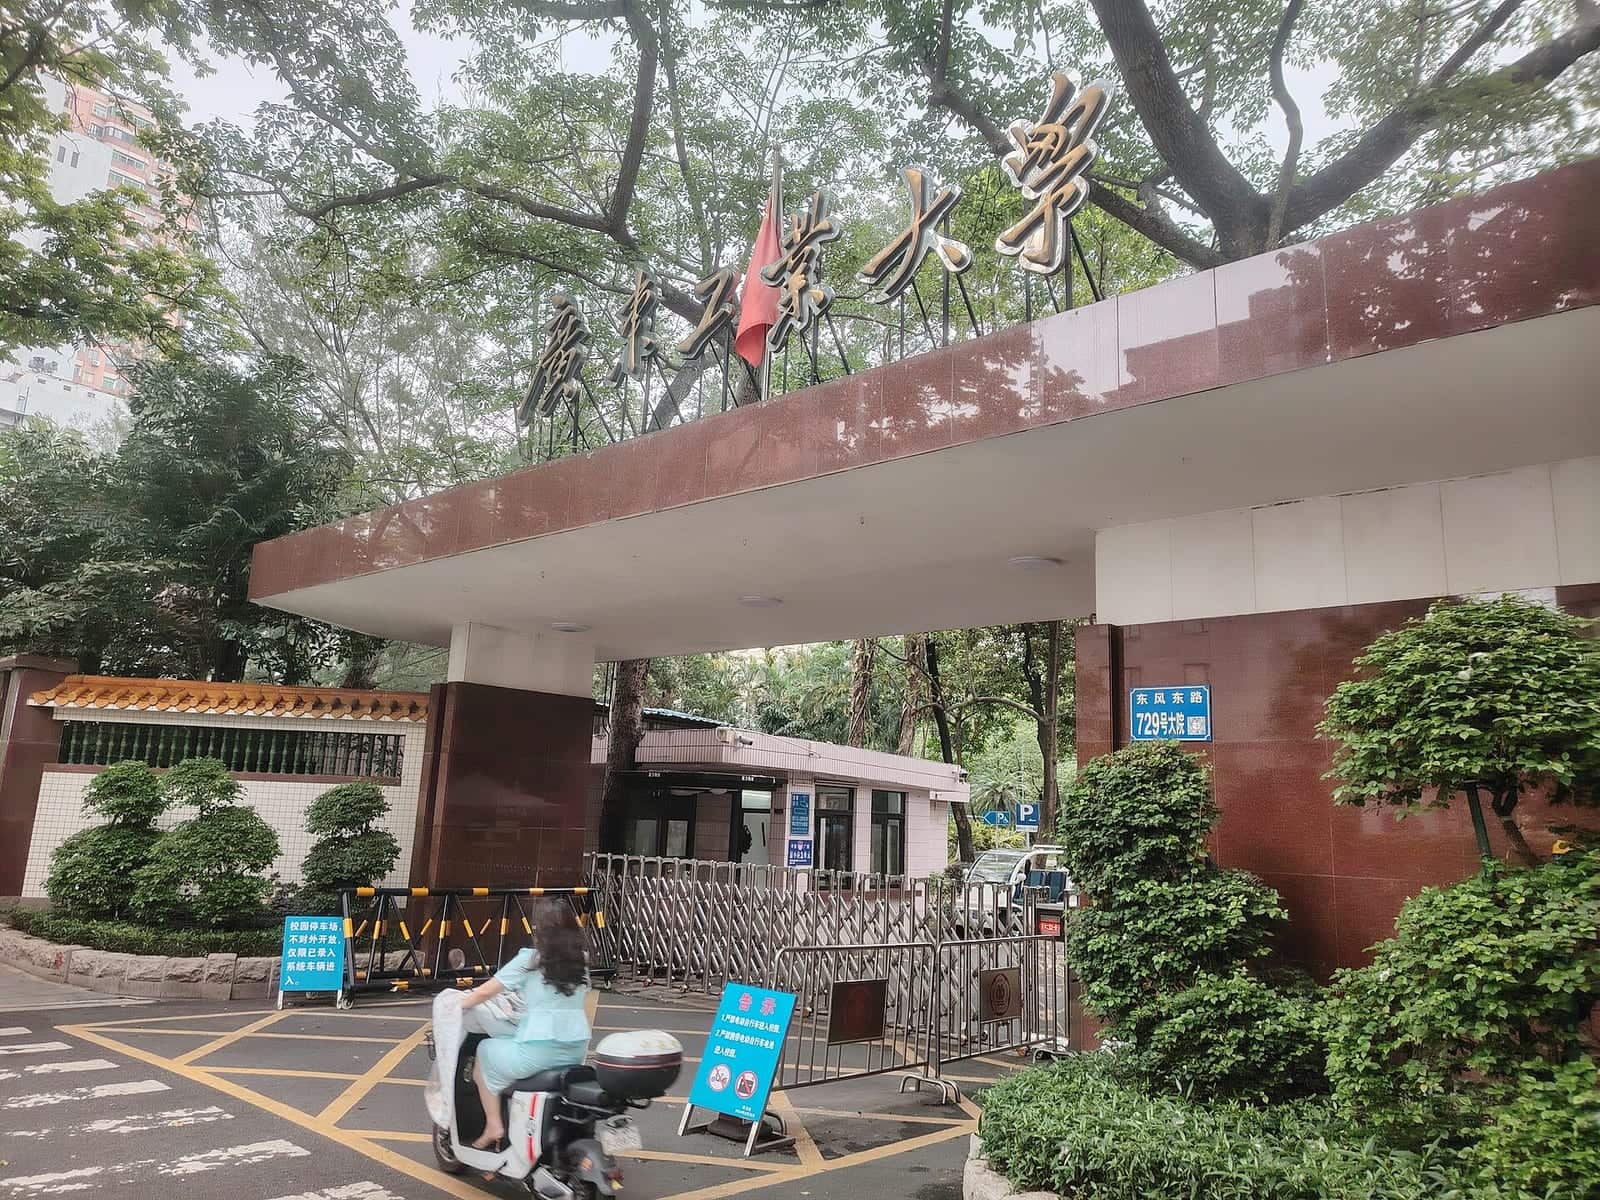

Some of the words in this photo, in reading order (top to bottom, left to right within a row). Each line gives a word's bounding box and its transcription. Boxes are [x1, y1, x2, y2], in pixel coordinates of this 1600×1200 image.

[1136, 691, 1203, 705] 东风东路
[1136, 711, 1185, 736] 729号大院
[1020, 804, 1033, 822] P
[287, 947, 336, 958] 仅限已录入
[286, 961, 335, 972] 系统车辆进
[738, 992, 776, 1017] 告示
